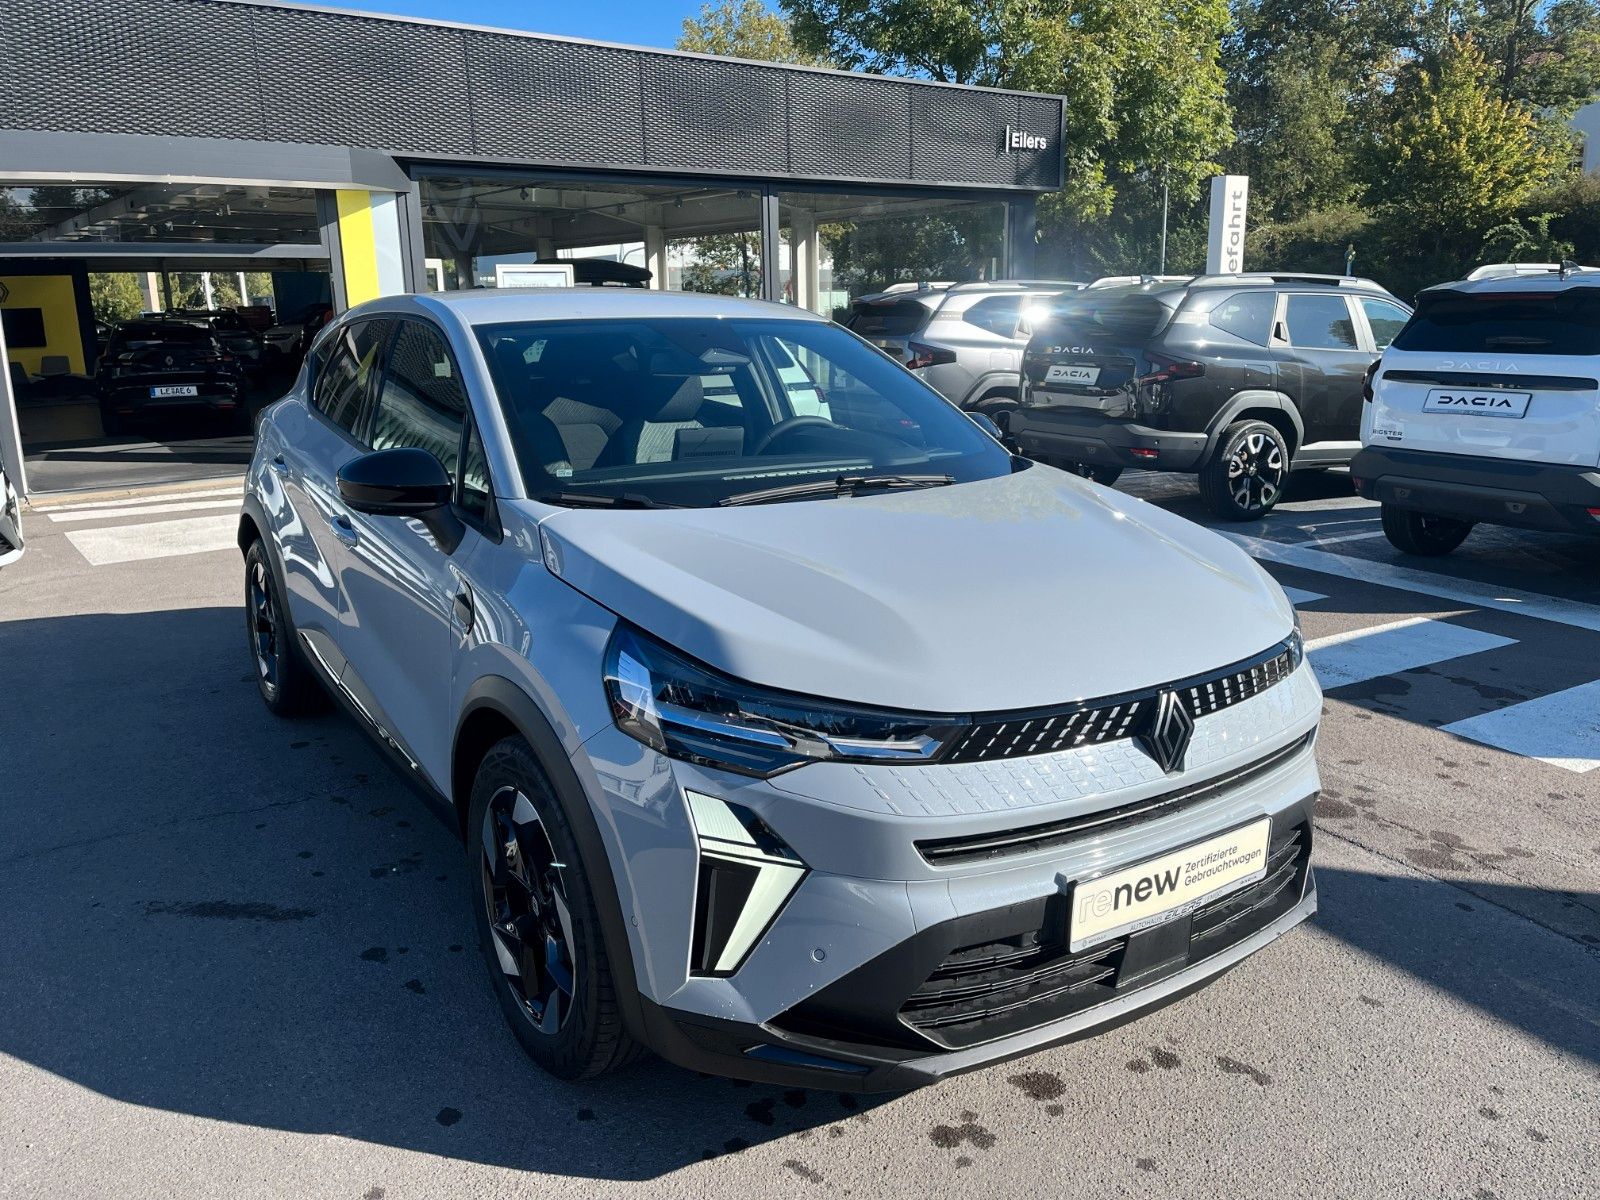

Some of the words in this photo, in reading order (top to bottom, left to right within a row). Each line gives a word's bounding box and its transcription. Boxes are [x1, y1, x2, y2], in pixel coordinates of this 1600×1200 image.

[1011, 131, 1047, 150] Eilers
[1053, 346, 1095, 354] DACIA
[1052, 369, 1091, 379] DACIA
[1437, 360, 1520, 372] DACIA
[1437, 395, 1512, 408] DACIA
[1185, 845, 1238, 874] Zertifizierte
[1184, 849, 1262, 887] Gebrauchtwagen
[1079, 866, 1181, 924] renew
[1130, 915, 1163, 931] AUTOHAUS
